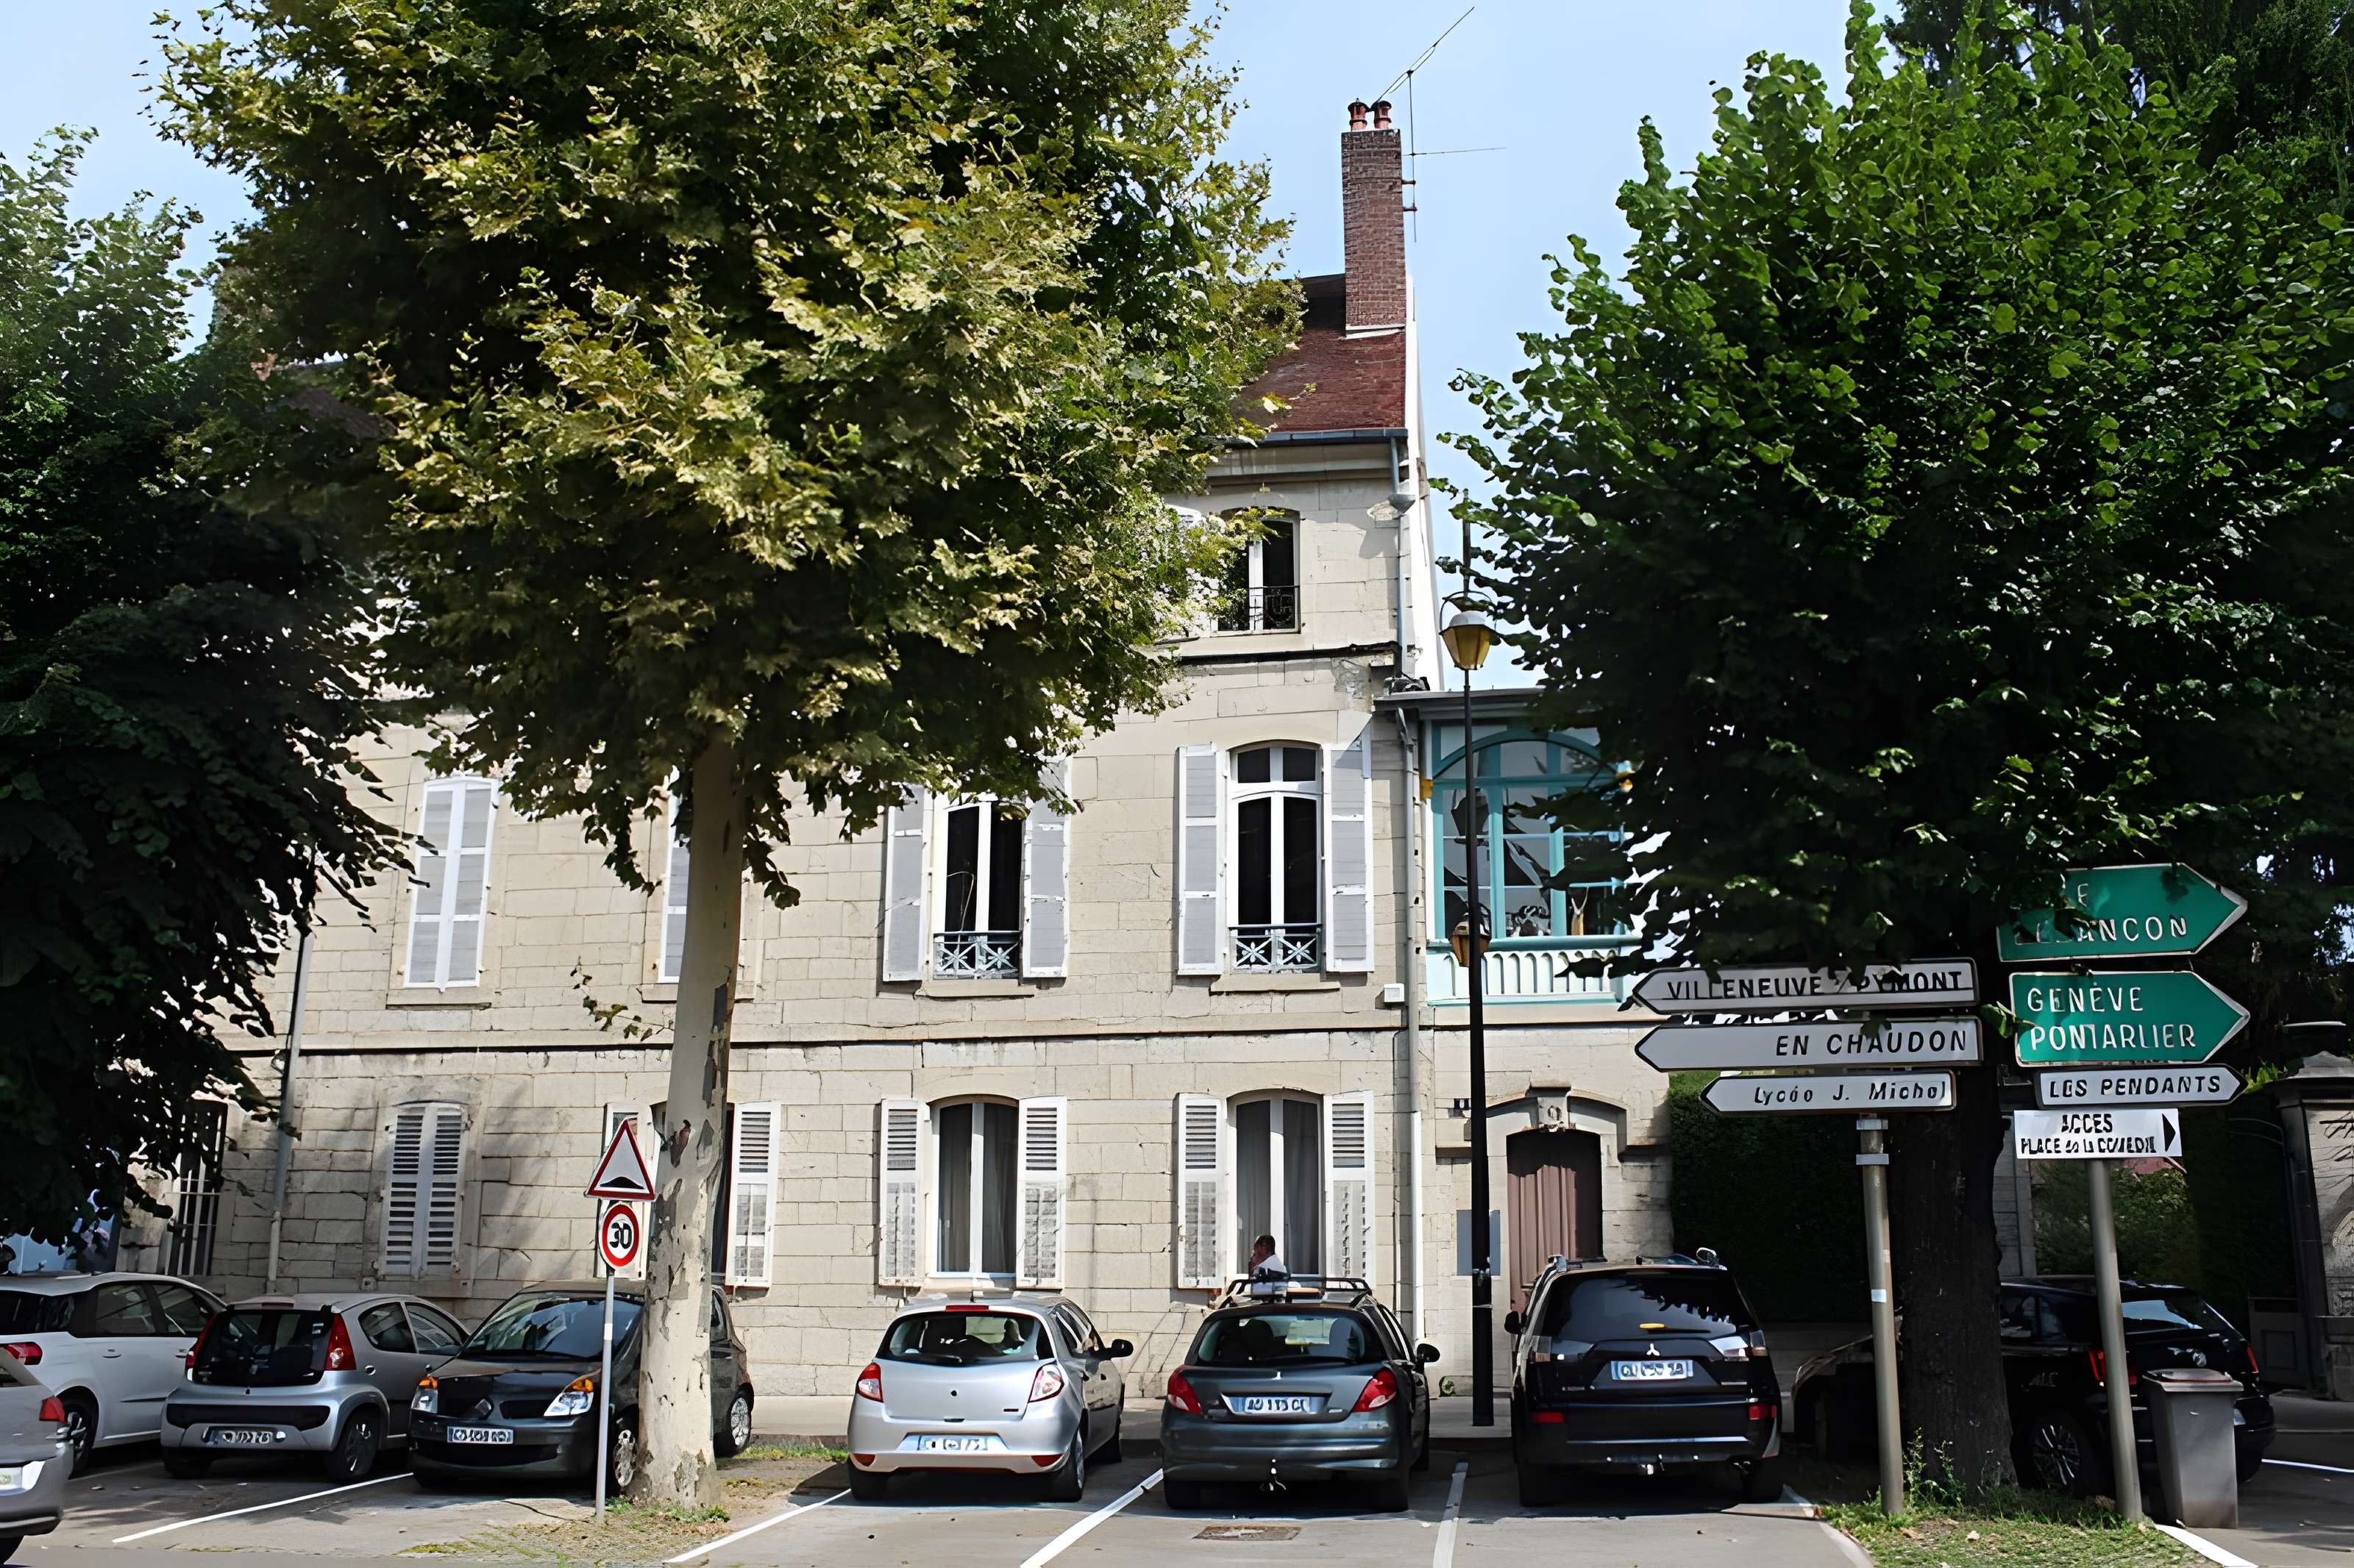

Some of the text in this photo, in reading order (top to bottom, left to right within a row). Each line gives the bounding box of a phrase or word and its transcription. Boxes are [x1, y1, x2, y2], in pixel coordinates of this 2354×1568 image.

[1667, 976, 1825, 1000] VILLENEUVE
[1776, 1030, 1966, 1056] EN CHAUDON
[2030, 1023, 2196, 1050] PONTARLIER
[1832, 1084, 1849, 1101] J.
[2100, 1075, 2221, 1096] PENDANTS
[2021, 1137, 2061, 1155] PLACE
[609, 1222, 633, 1250] 30
